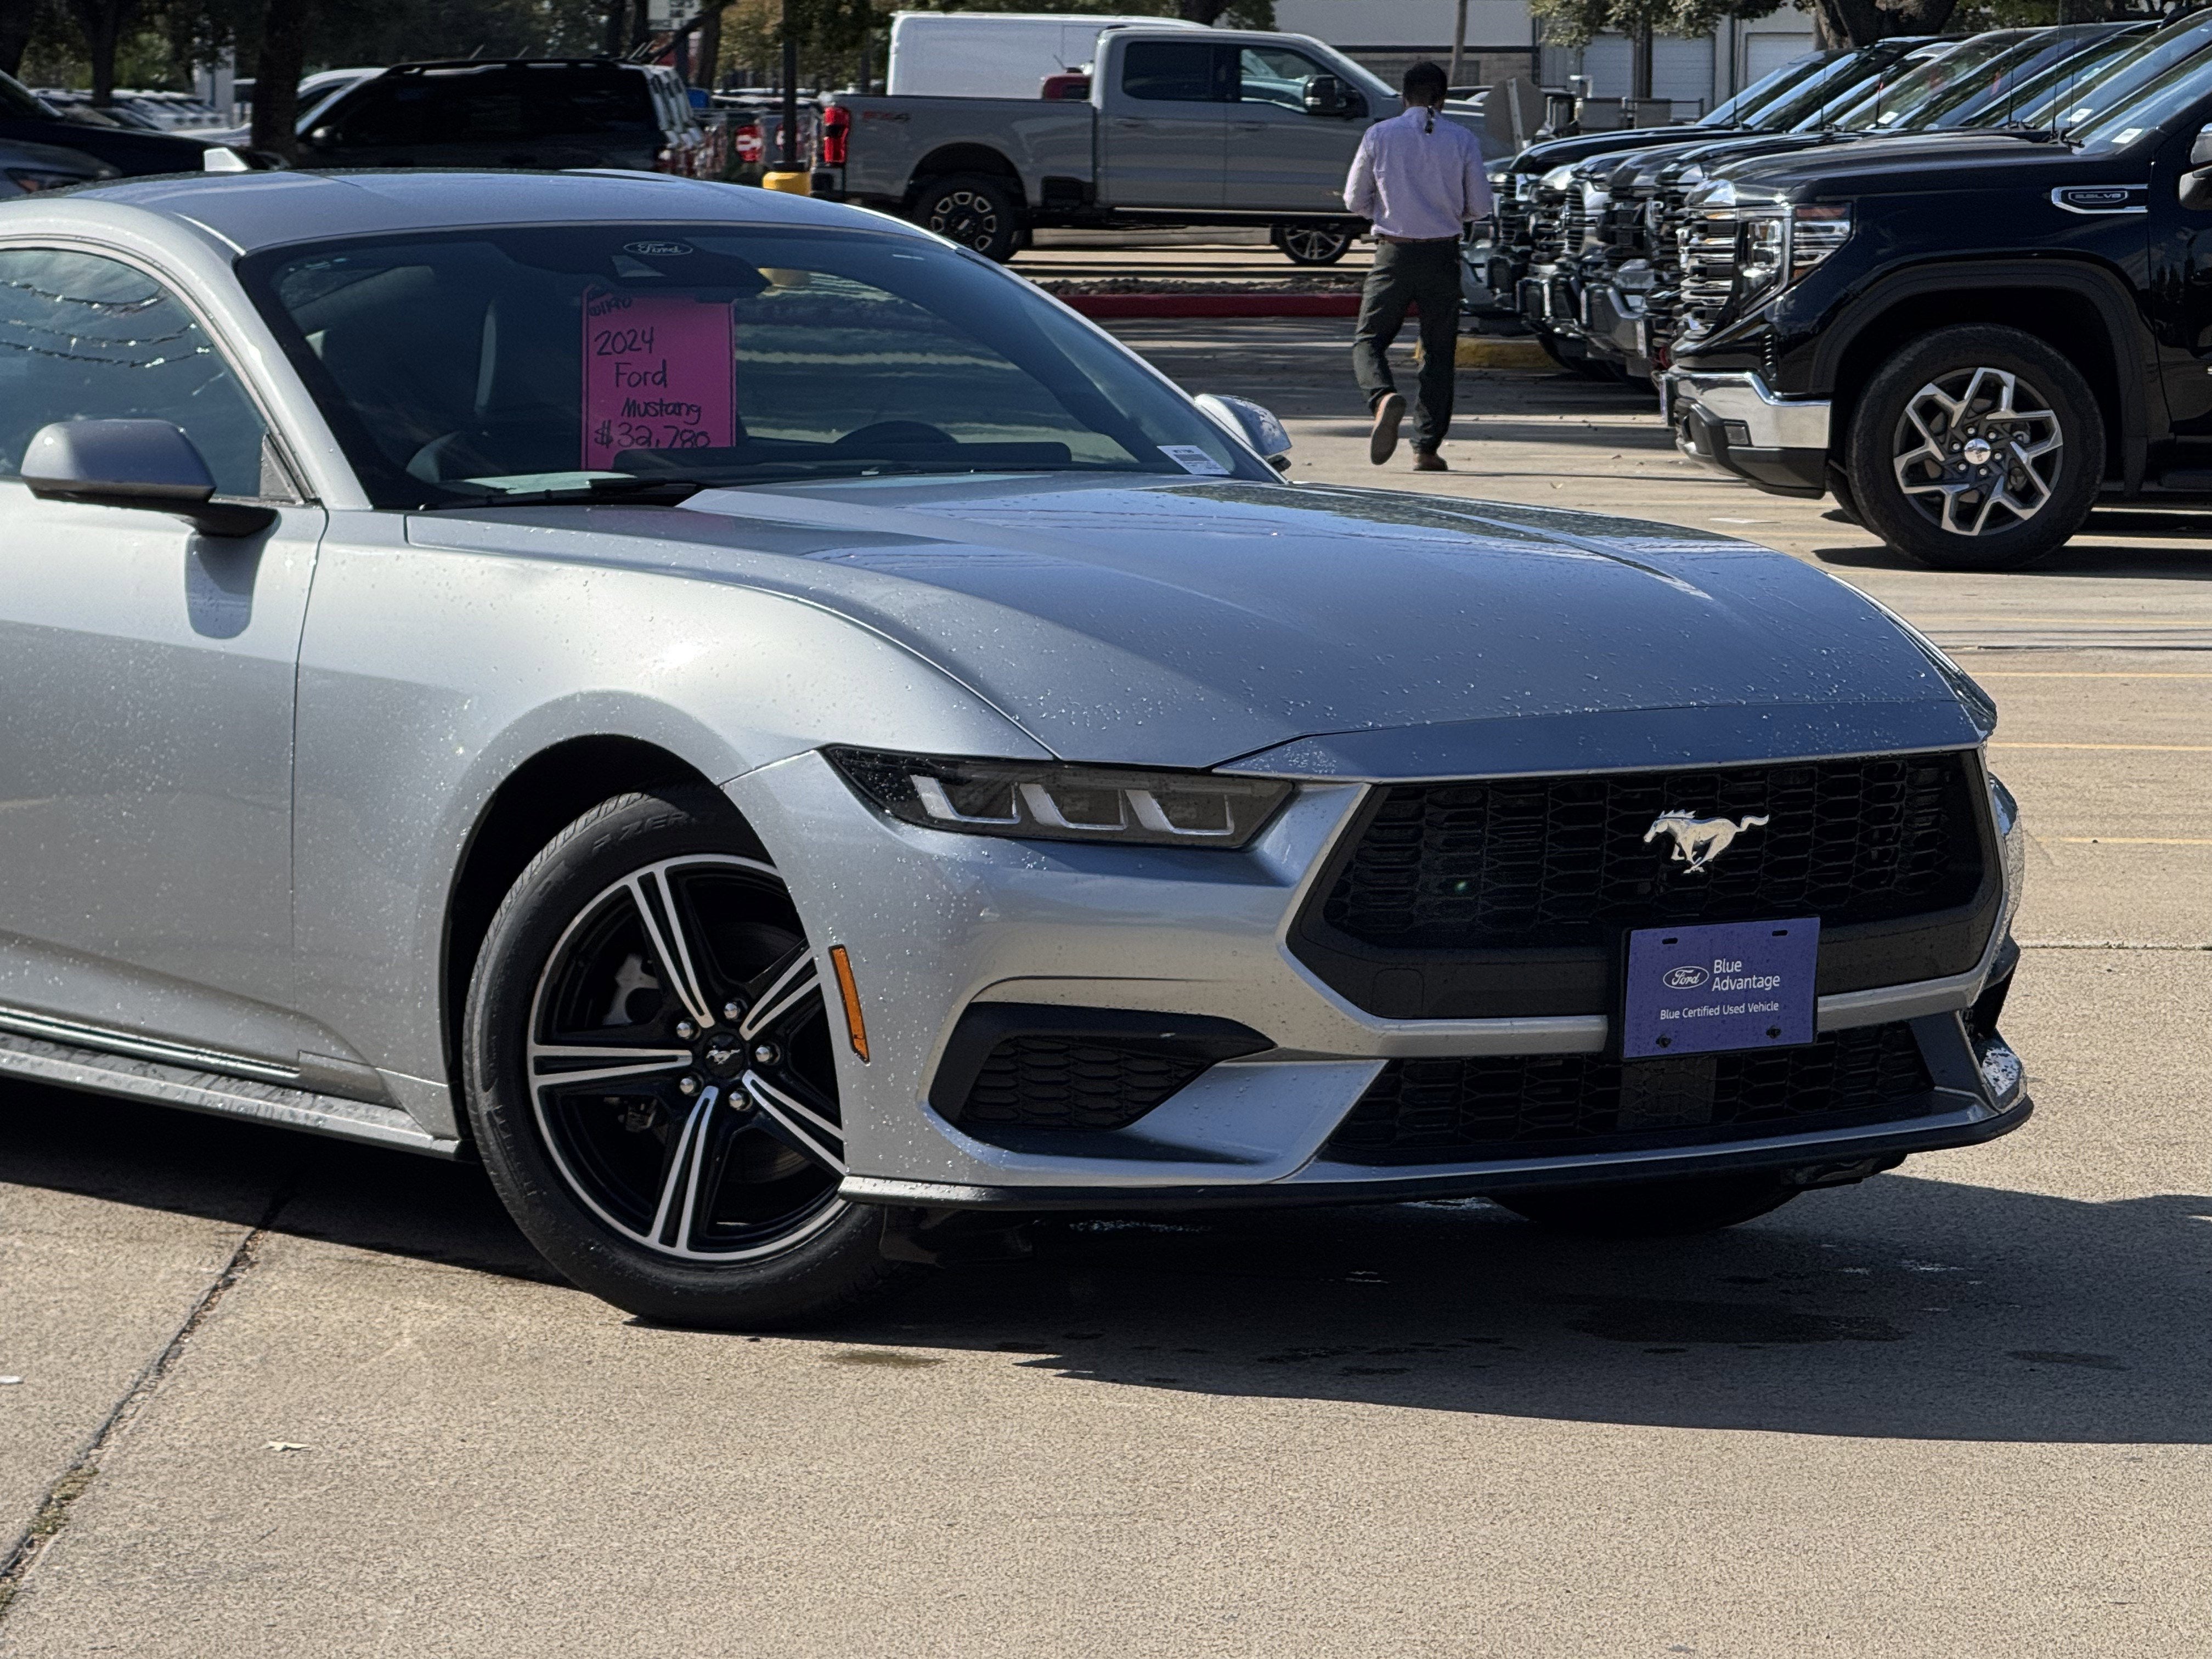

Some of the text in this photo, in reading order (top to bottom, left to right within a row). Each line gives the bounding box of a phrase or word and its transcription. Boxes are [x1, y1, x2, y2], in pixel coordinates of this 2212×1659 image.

[594, 326, 654, 356] 2024
[614, 359, 667, 388] Ford
[621, 398, 702, 426] Mustang
[594, 420, 711, 449] $32,780
[1672, 969, 1700, 986] Ford
[1713, 958, 1742, 974] Blue
[1712, 974, 1780, 992] Advantage
[1660, 1001, 1779, 1020] Blue Certified Used Vehicle
